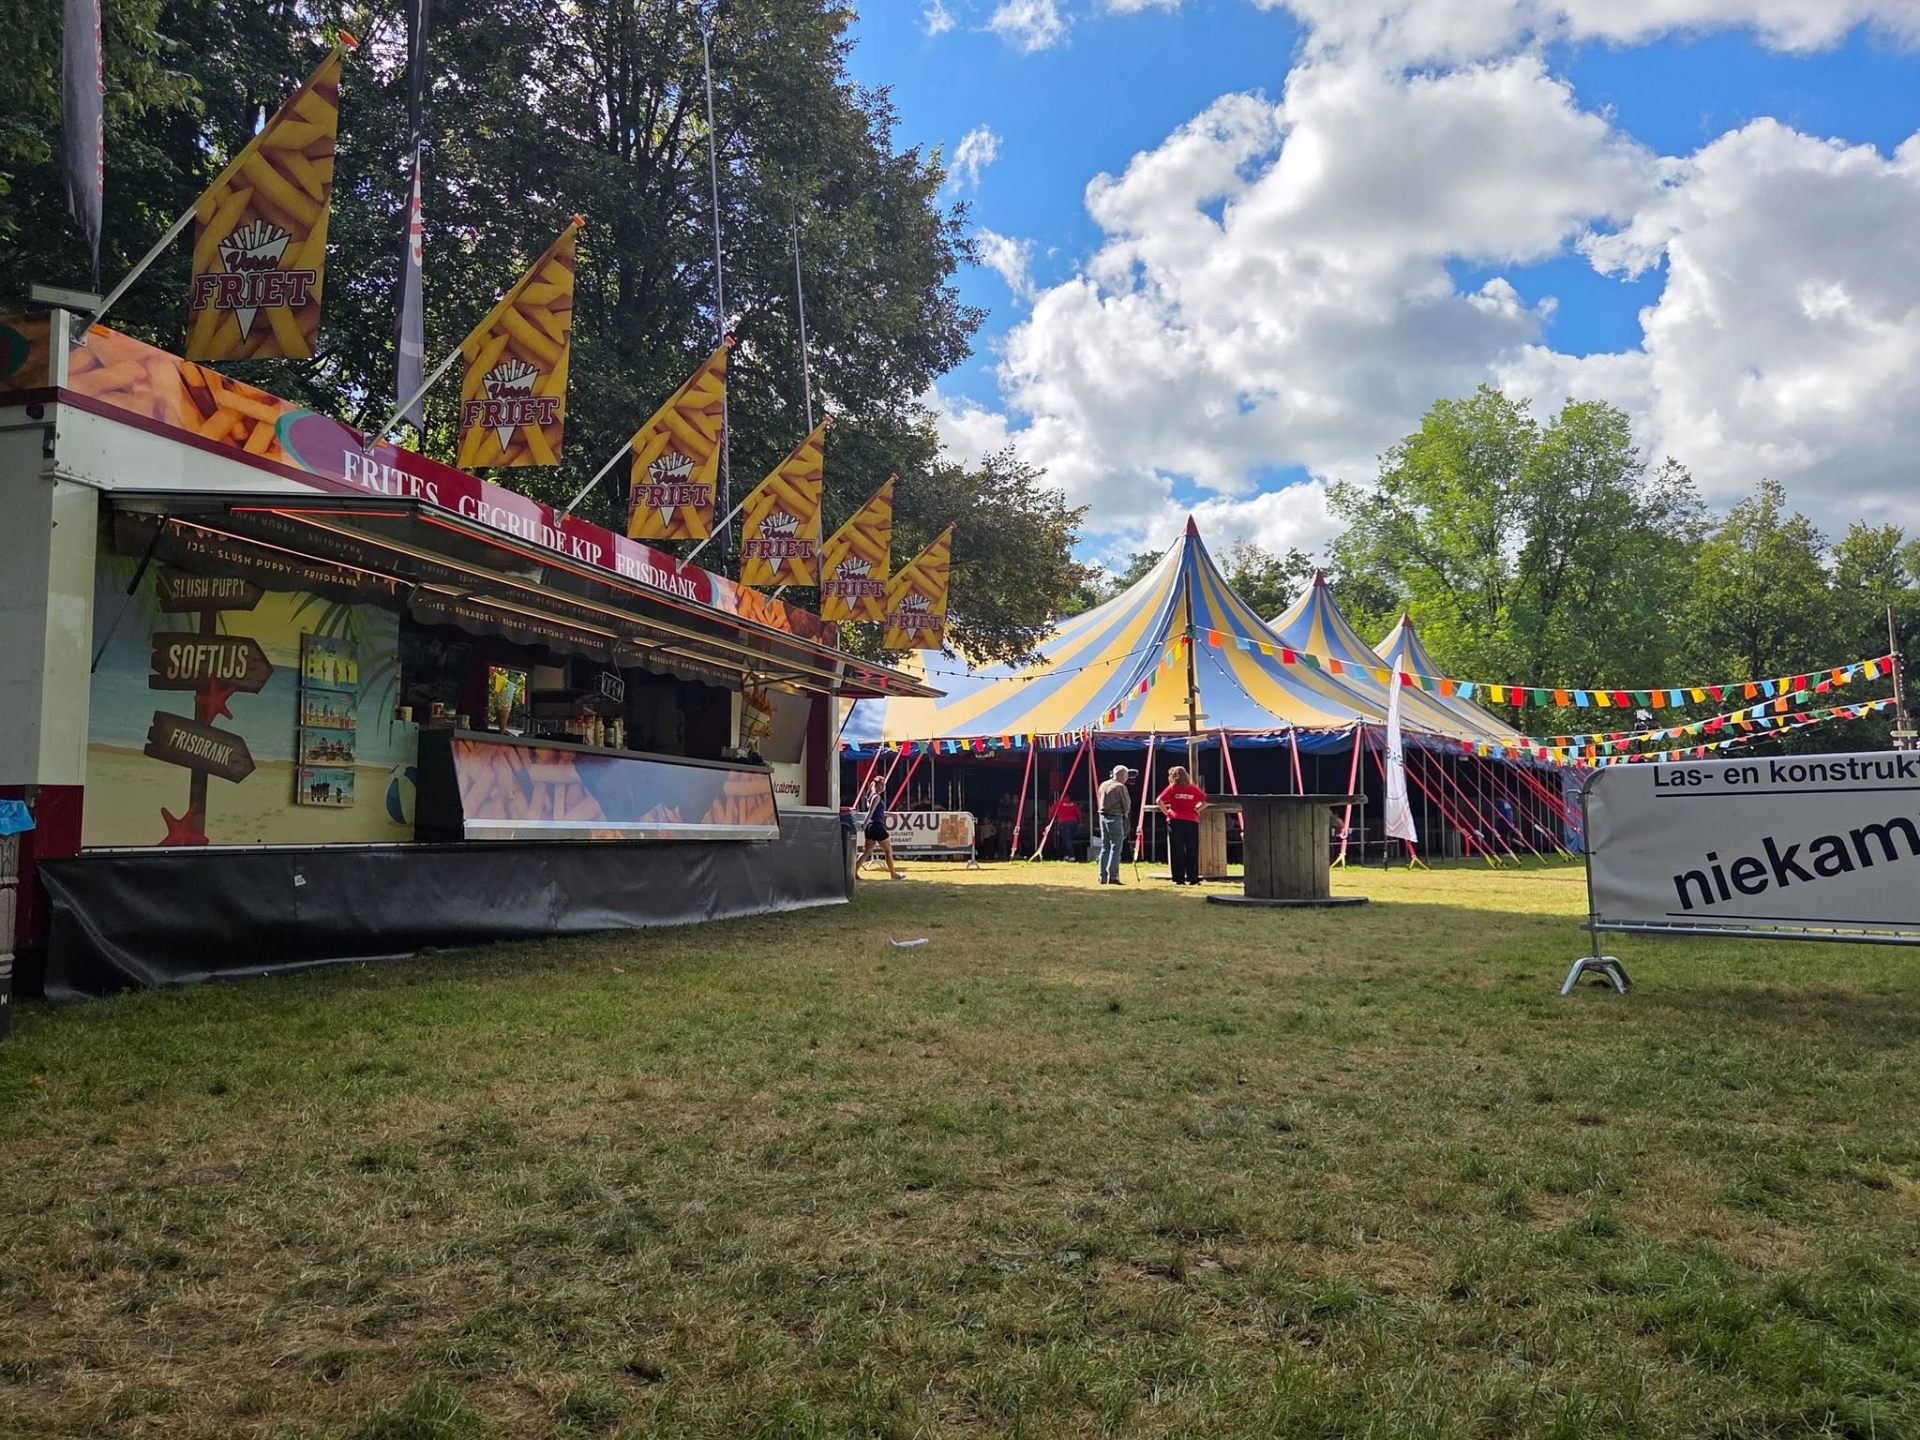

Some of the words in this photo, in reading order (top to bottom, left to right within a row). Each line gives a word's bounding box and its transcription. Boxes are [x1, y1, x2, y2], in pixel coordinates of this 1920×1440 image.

[225, 251, 278, 273] Verse
[193, 270, 316, 311] FRIET
[462, 396, 560, 429] FRIET
[631, 482, 711, 508] FRIET
[342, 449, 440, 506] FRITES
[458, 494, 568, 555] GEGRILDE
[571, 534, 603, 566] KIP
[616, 553, 698, 602] FRISDRANK
[743, 538, 815, 560] FRIET
[218, 549, 251, 566] SLUSH
[256, 557, 293, 575] PUPPY
[303, 568, 359, 588] FRISDRANK
[173, 578, 209, 599] SLUSH
[211, 577, 247, 598] PUPPY
[823, 579, 886, 598] FRIET
[886, 613, 942, 631] FRIET
[167, 643, 250, 680] SOFTIJS
[168, 728, 234, 766] FRISDRANK
[1653, 765, 1714, 788] Las-
[1724, 766, 1759, 785] en
[1770, 754, 1920, 783] konstruk
[885, 812, 940, 831] OX4U
[1672, 812, 1920, 911] niekam
